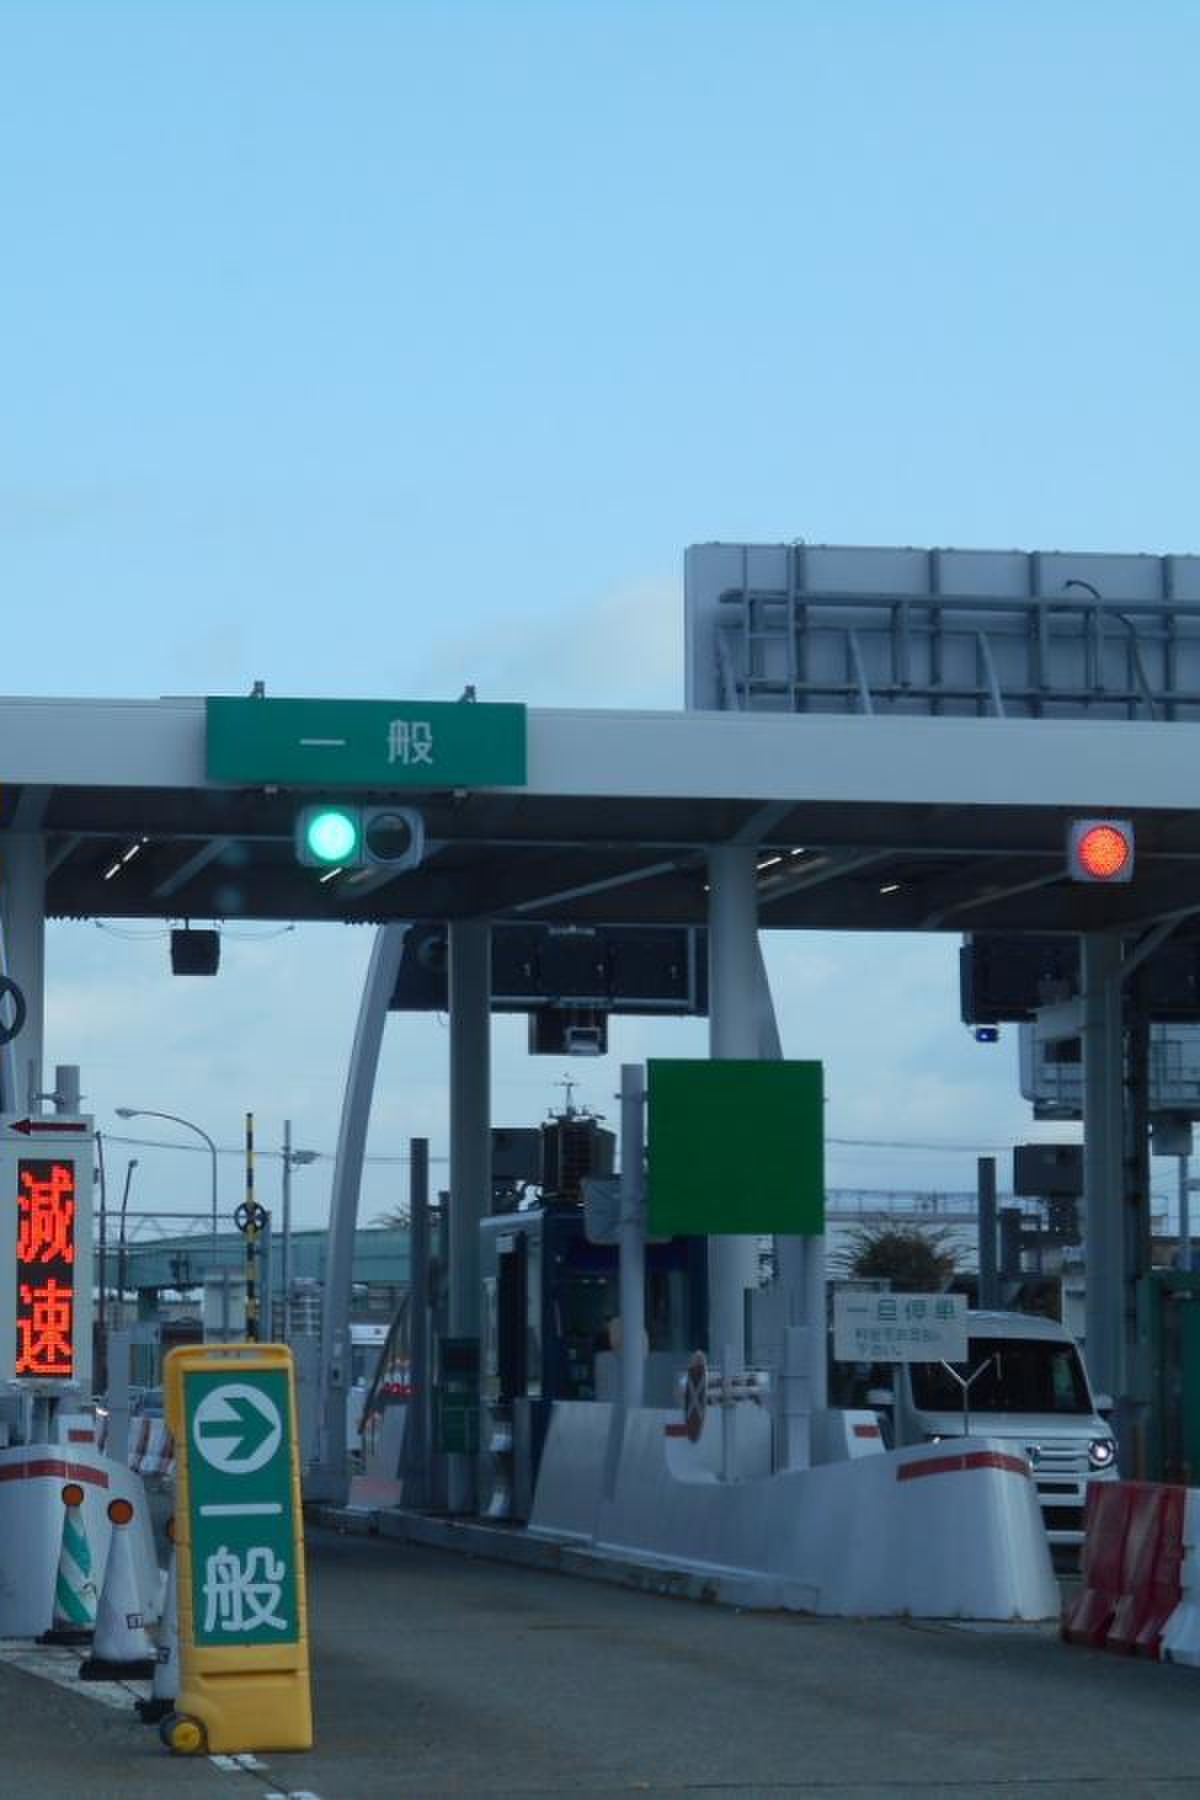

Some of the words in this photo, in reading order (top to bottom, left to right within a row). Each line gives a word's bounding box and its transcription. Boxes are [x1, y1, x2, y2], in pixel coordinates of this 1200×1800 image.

[299, 718, 434, 765] 一般
[16, 1166, 75, 1374] 減速
[200, 1503, 288, 1632] 一般
